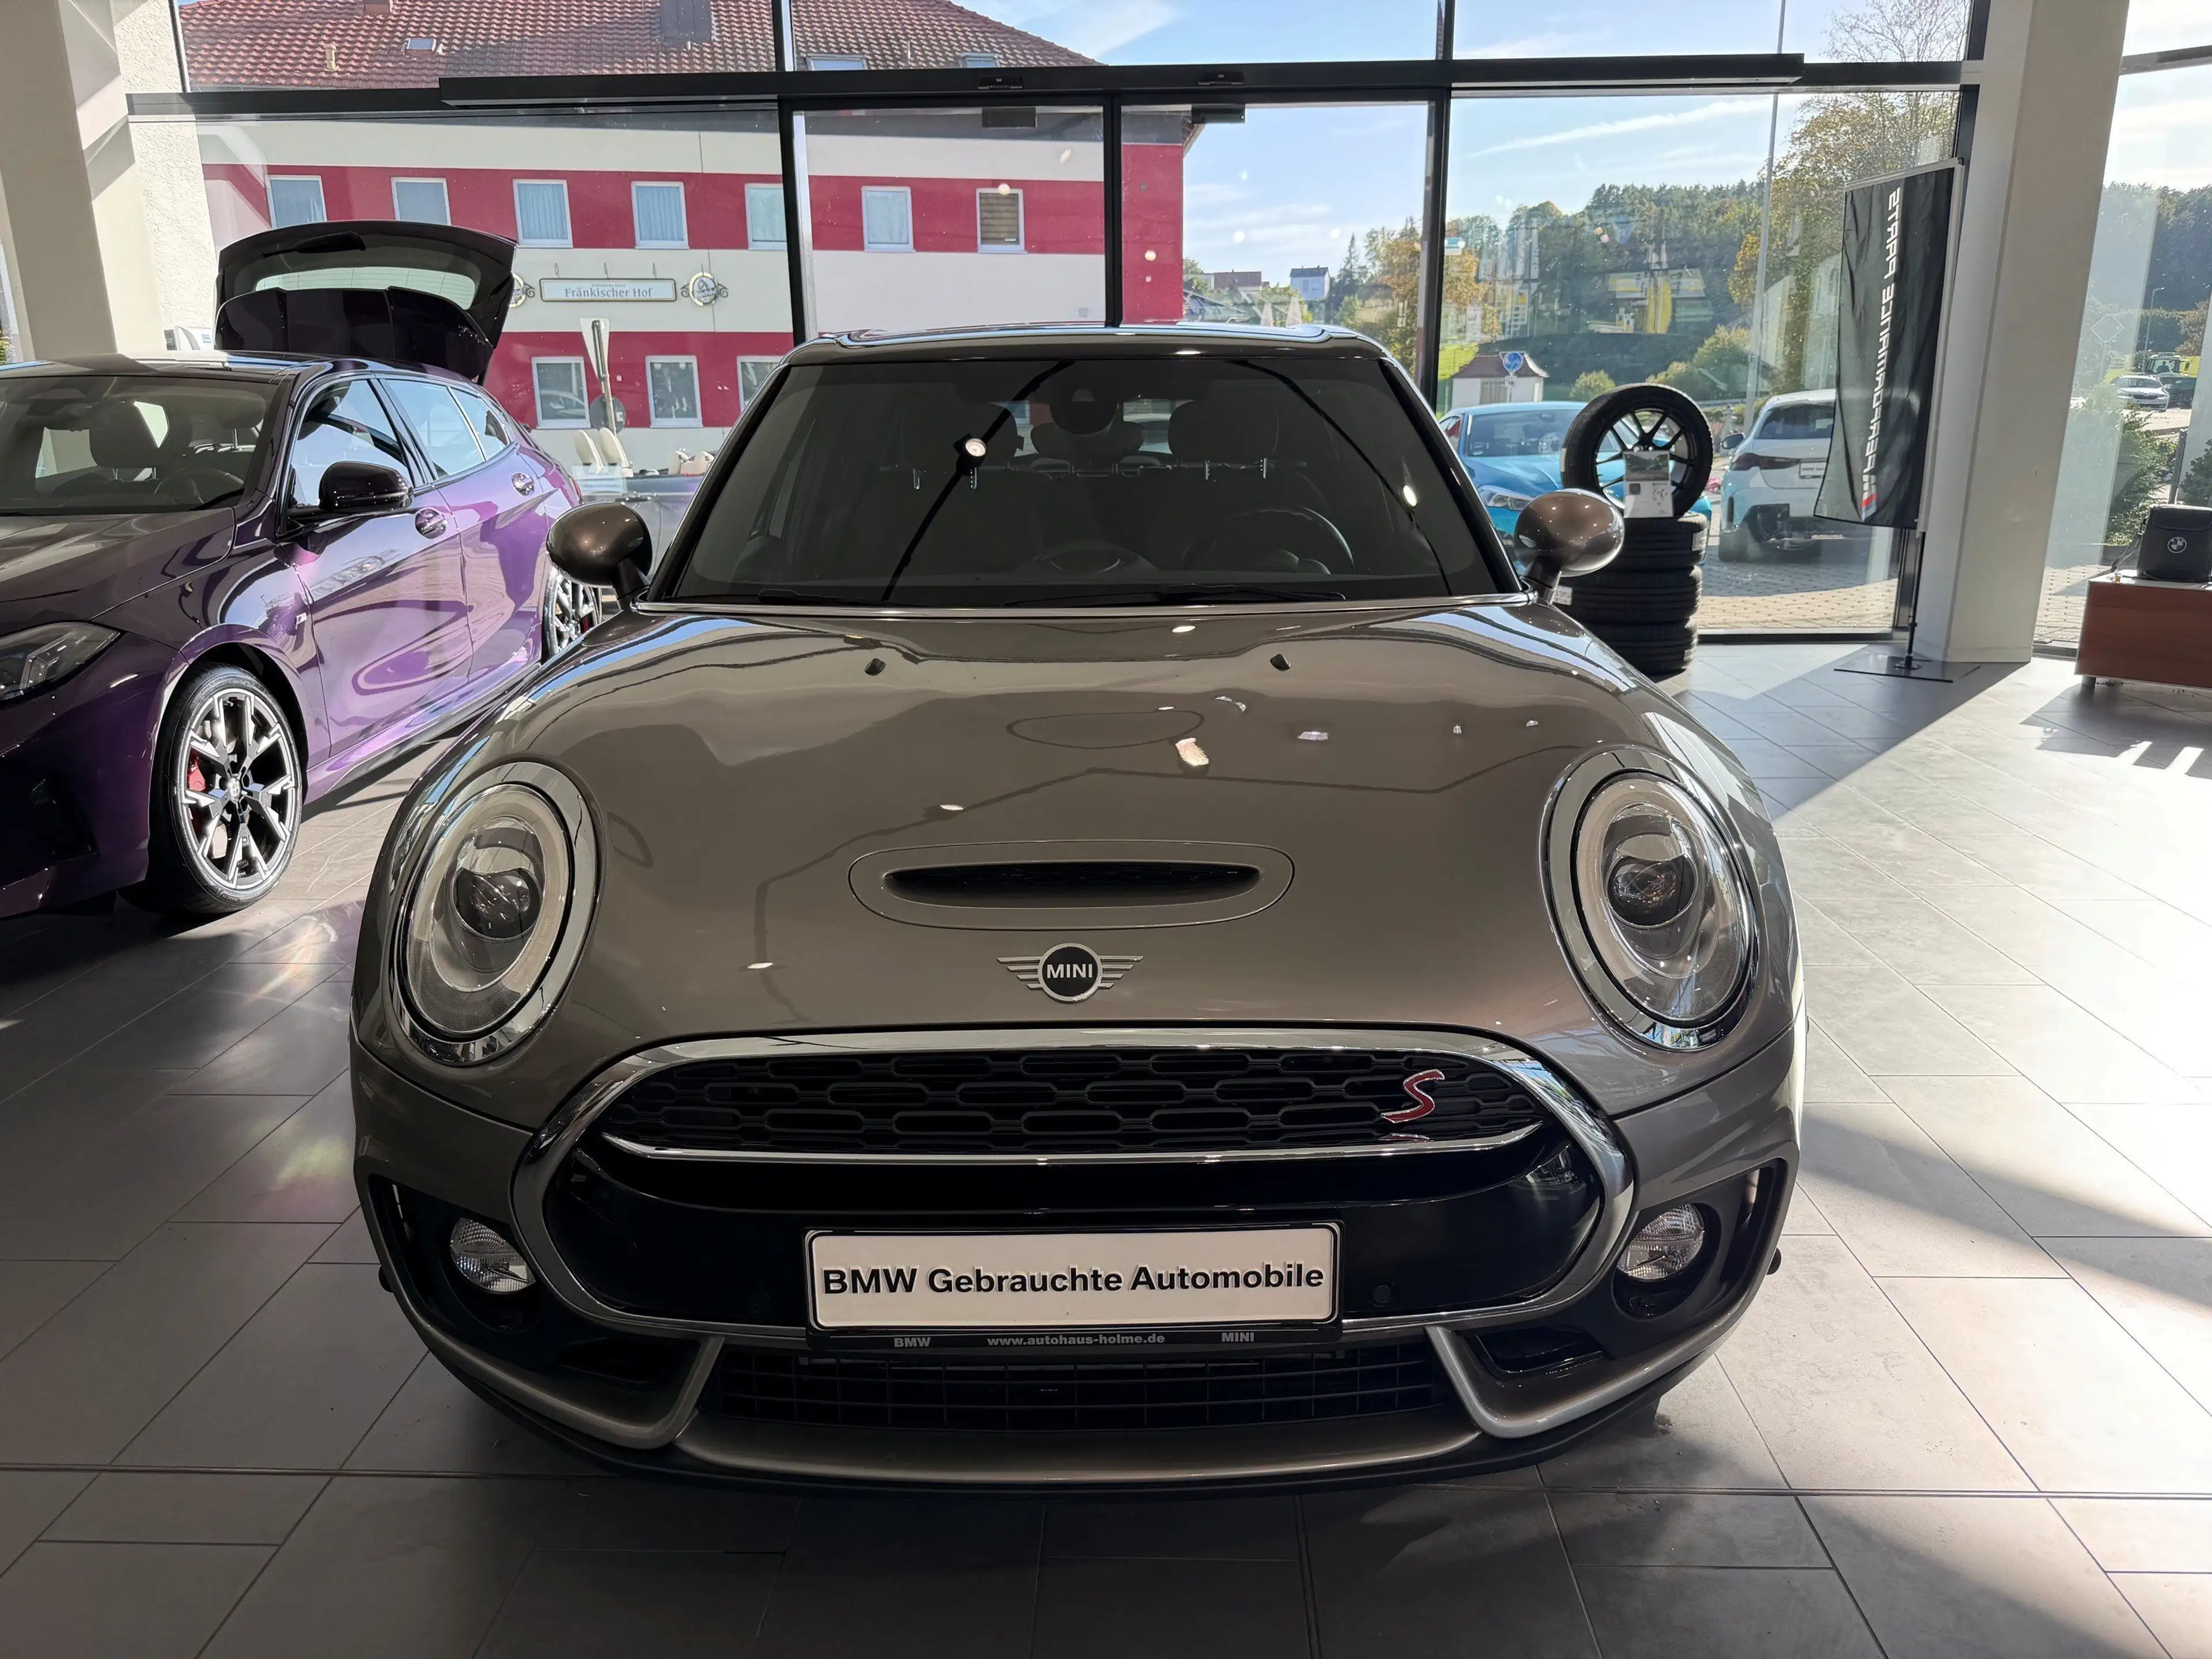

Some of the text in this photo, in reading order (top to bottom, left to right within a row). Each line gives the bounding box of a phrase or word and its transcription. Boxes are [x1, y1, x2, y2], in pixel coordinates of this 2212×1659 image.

[565, 287, 653, 298] Fränkischer Hof
[1047, 963, 1093, 979] MINI
[1380, 1069, 1445, 1123] S
[823, 1263, 1324, 1294] BMW Gebrauchte Automobile
[893, 1332, 1255, 1347] BMW www.autohaus-holme.de MINI
